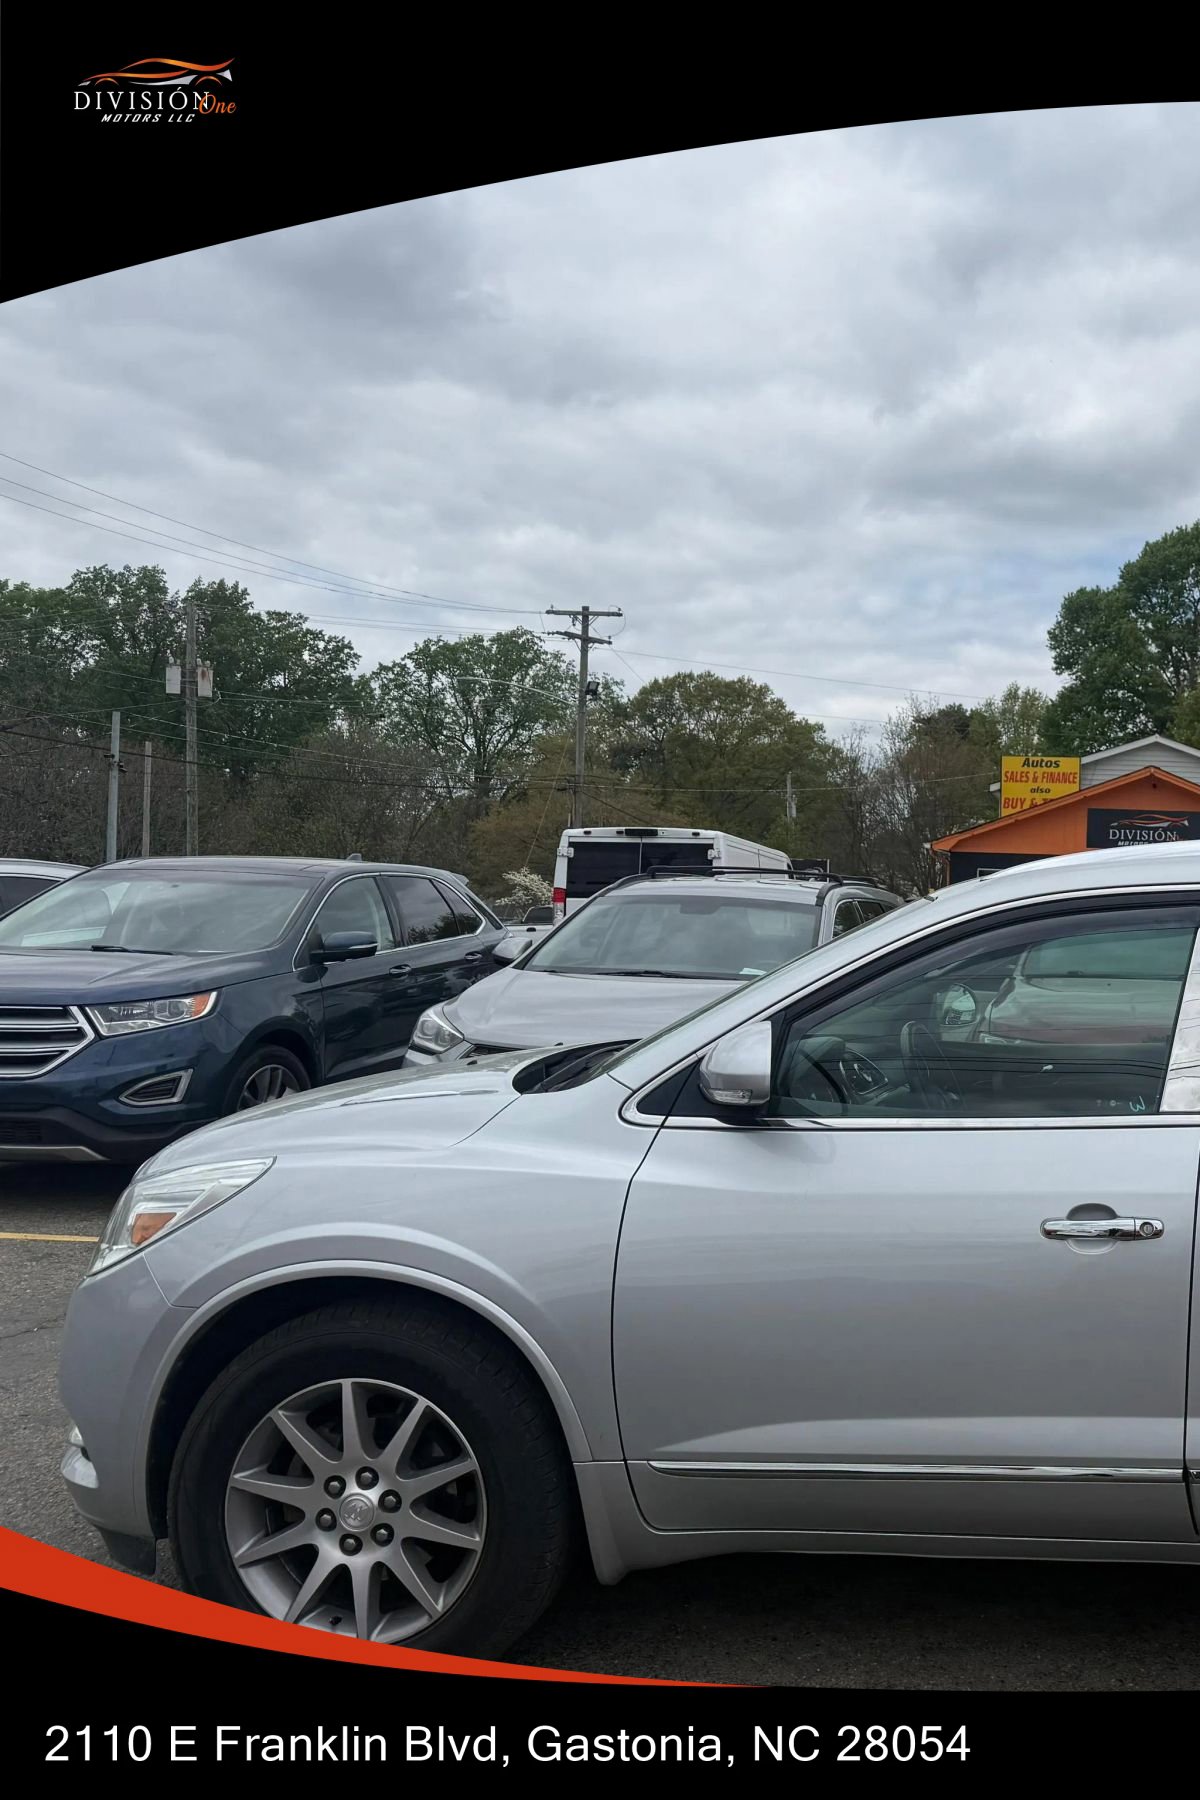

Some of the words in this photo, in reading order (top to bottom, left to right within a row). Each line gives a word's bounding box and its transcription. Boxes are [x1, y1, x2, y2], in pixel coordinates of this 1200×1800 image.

[1021, 757, 1061, 769] Autos
[1004, 770, 1030, 783] SALES
[1041, 771, 1078, 784] FINANCE
[1030, 786, 1051, 794] also
[1002, 796, 1026, 810] BUY
